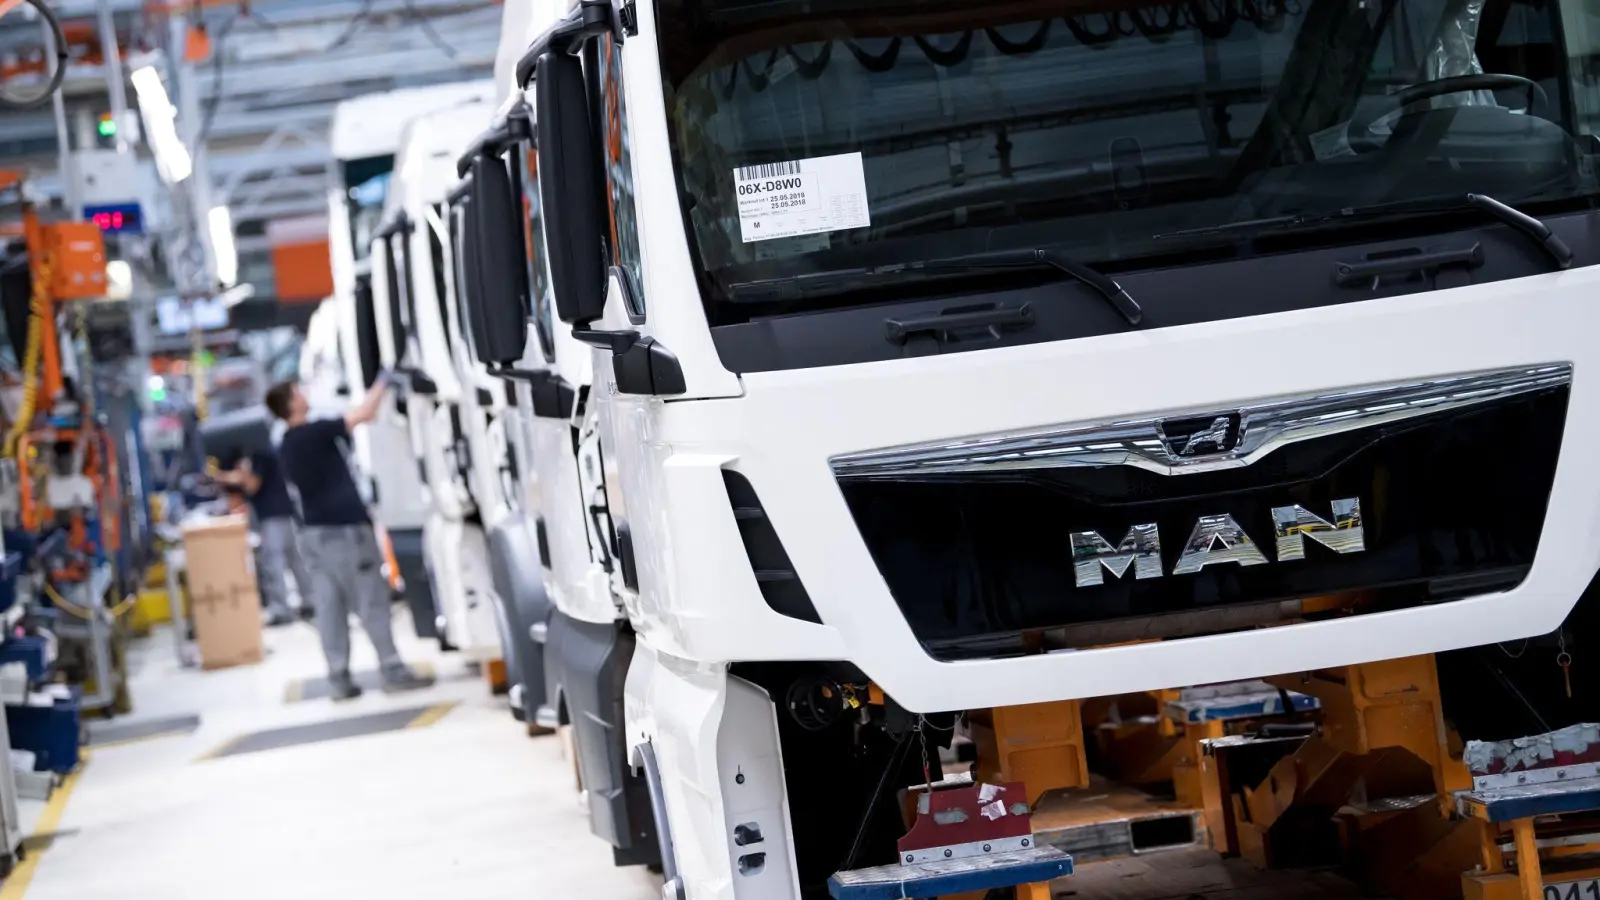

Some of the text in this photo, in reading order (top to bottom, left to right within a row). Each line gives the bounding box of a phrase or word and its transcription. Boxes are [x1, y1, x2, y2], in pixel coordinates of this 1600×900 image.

[738, 178, 802, 195] 06X-D8W0
[770, 192, 806, 203] 25.05.2018
[771, 199, 807, 210] 25.05.2018
[753, 221, 761, 229] M
[1069, 497, 1366, 588] MAN
